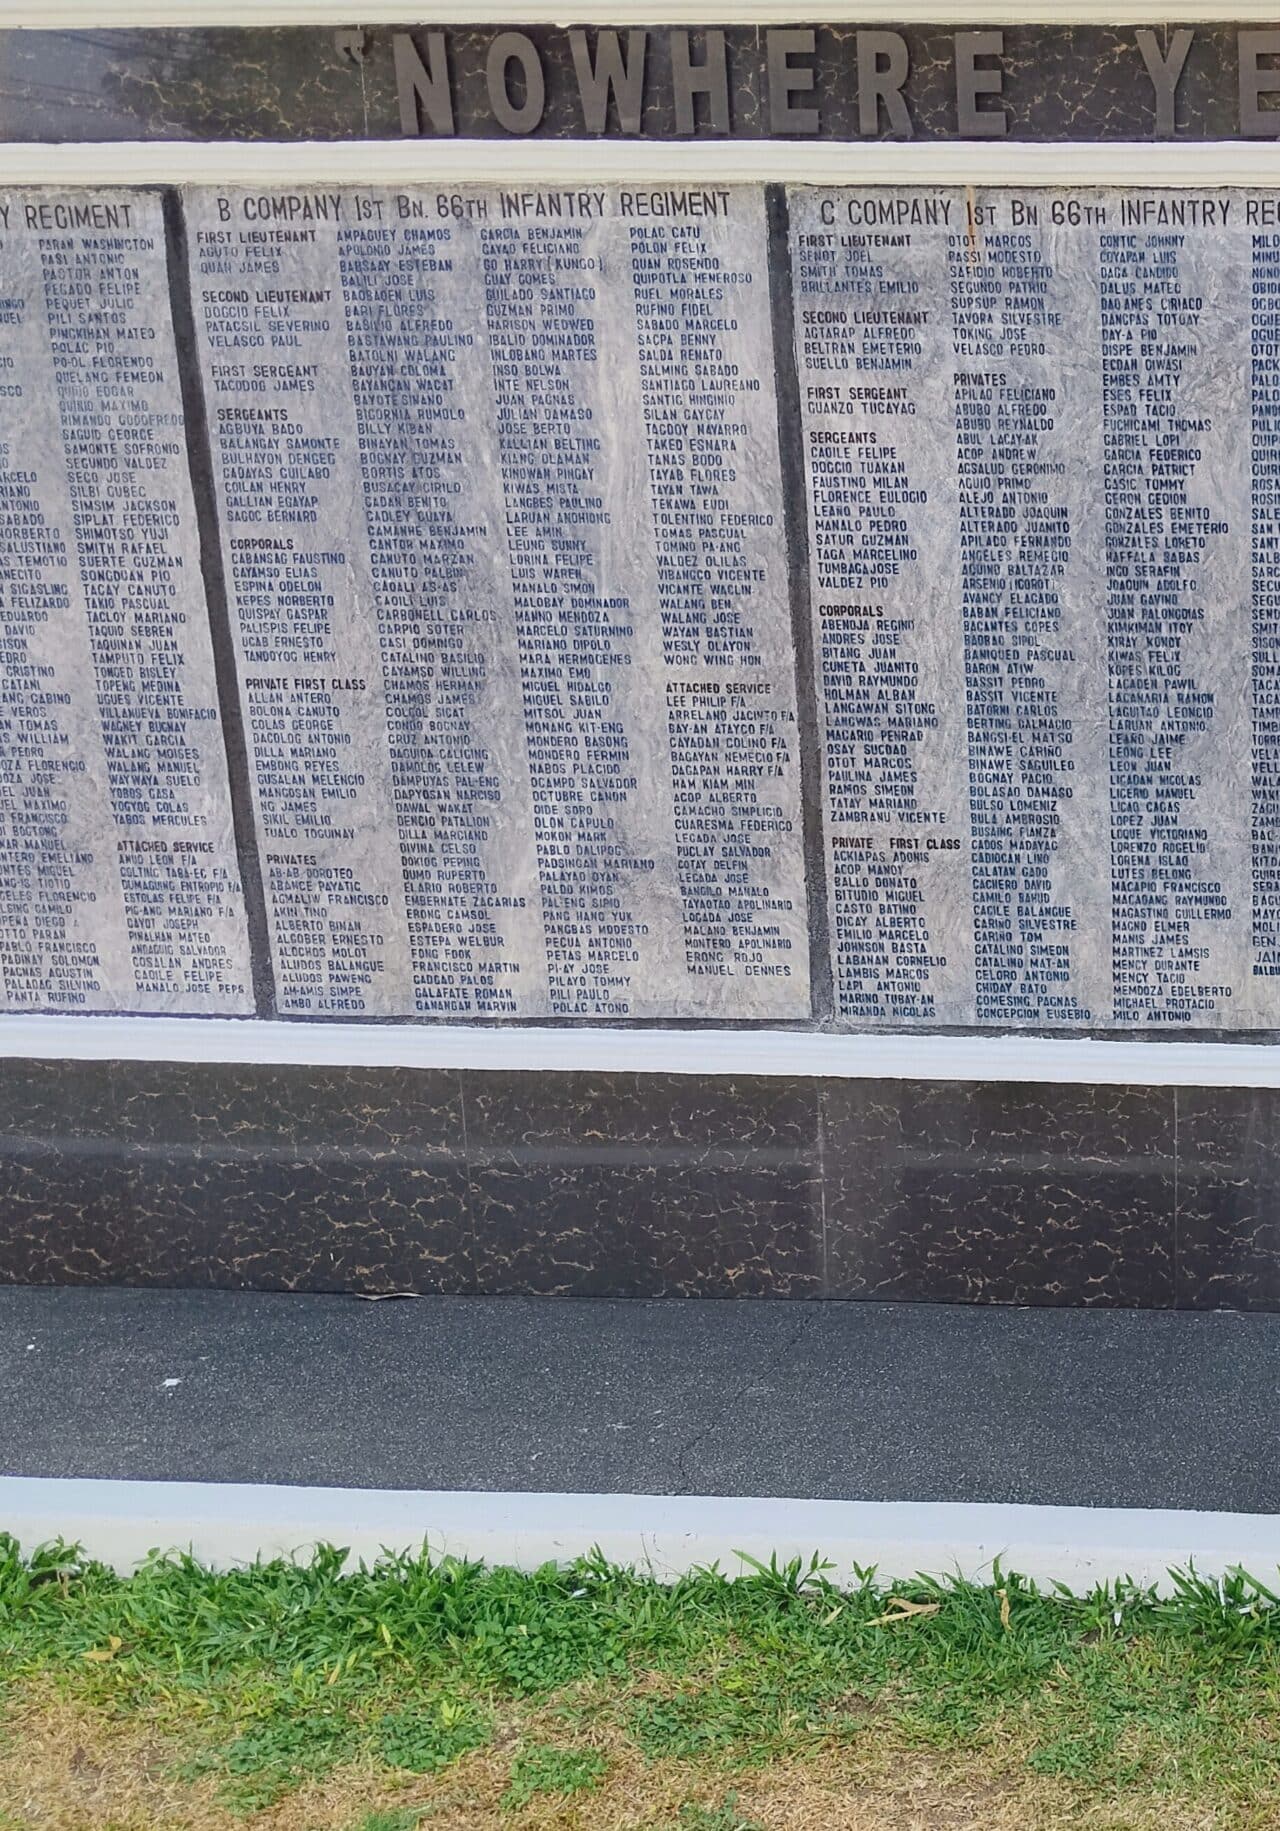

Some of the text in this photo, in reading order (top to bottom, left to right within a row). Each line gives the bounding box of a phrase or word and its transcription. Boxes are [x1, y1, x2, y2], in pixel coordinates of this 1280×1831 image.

[218, 197, 231, 221] B
[244, 197, 344, 221] COMPANY
[500, 192, 605, 218] INFANTRY
[621, 192, 729, 218] REGIMENT
[821, 200, 835, 226] C
[848, 200, 951, 226] COMPANY
[1121, 200, 1232, 226] INFANTRY
[25, 205, 130, 229] REGIMENT
[798, 234, 911, 247] FIRST LIEUTENANT
[681, 303, 713, 317] FIDEL
[78, 312, 127, 324] SANTOS
[804, 341, 922, 355] BELTRAN EMETERIO
[805, 357, 912, 370] SUELLO BENJAMIN
[953, 373, 1007, 386] PRIVATES
[497, 422, 571, 435] JOSE BERTO
[809, 431, 877, 444] SERGEANTS
[812, 476, 909, 489] FAUSTINO MILAN
[959, 491, 1049, 504] ALEJO ANTONIO
[71, 500, 115, 512] SIMSIM
[230, 538, 294, 550] CORPORALS
[816, 533, 854, 546] SATUR
[77, 542, 166, 555] SMITH RAFAEL
[78, 555, 126, 568] SUERTE
[285, 566, 318, 579] ELIAS
[819, 604, 884, 617] CORPORALS
[239, 622, 331, 635] PALISPIS FELIPE
[274, 636, 324, 648] ERNESTO
[871, 633, 900, 646] JOSE
[245, 678, 366, 691] PRIVATE FIRST CLASS
[666, 682, 771, 694] ATTACHED SERVICE
[248, 692, 332, 704] ALLAN ANTERO
[666, 695, 686, 708] LEE
[692, 696, 727, 708] PHILIP
[1011, 690, 1057, 703] VICENTE
[304, 760, 340, 772] REYES
[735, 779, 755, 790] MIN
[708, 792, 757, 803] ALBERTO
[831, 837, 961, 850] PRIVATE FIRST CLASS
[266, 854, 317, 865] PRIVATES
[1018, 919, 1077, 931] SILVESTRE
[1112, 934, 1189, 946] MANIS JAMES
[837, 941, 927, 954] JOHNSON BASTA
[1170, 947, 1210, 959] LAMSIS
[546, 949, 582, 961] PETAS
[411, 961, 520, 973] FRANCISCO MARTIN
[686, 964, 733, 976] MANUEL
[838, 967, 930, 980] LAMBIS MARCOS
